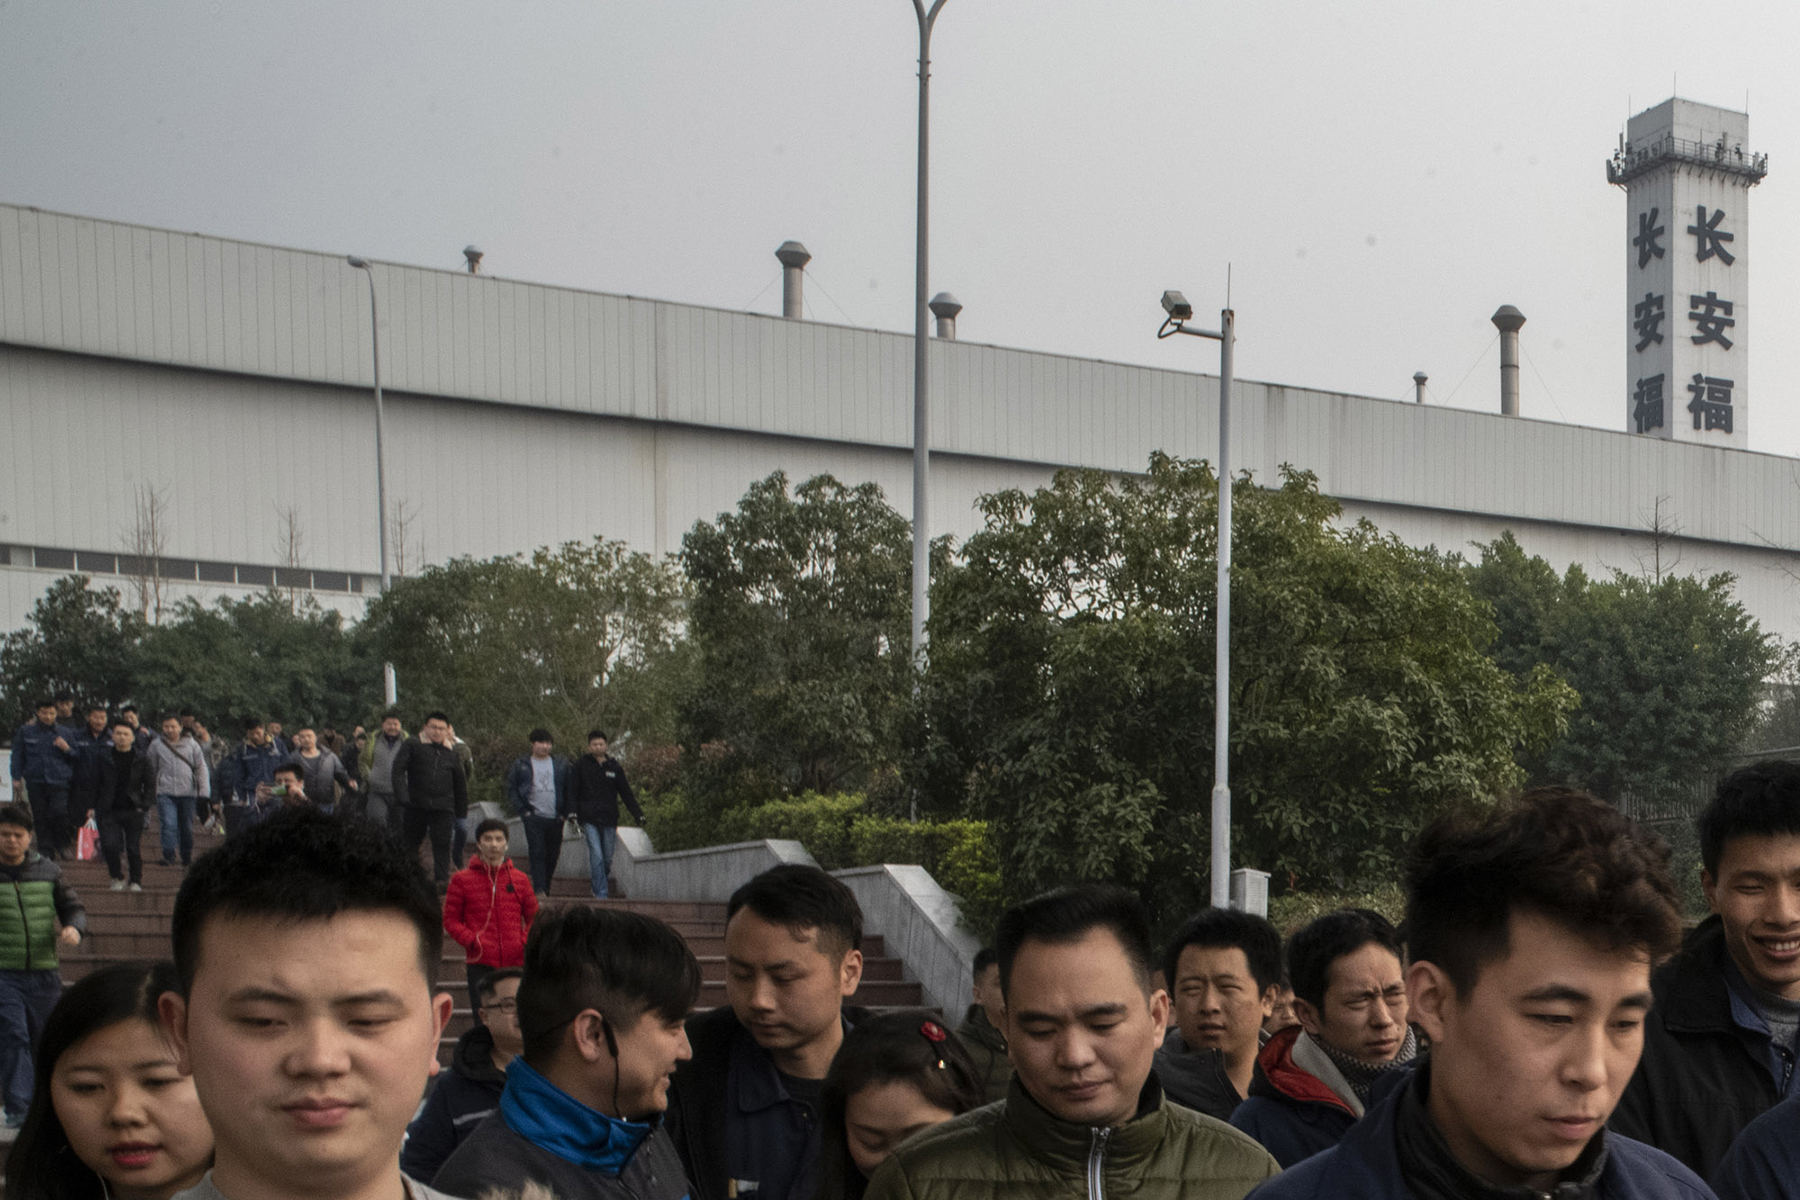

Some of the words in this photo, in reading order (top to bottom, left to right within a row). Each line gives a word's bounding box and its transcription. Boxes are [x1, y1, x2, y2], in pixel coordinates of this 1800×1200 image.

[1633, 207, 1665, 434] 长安福
[1687, 204, 1735, 434] 长安福
